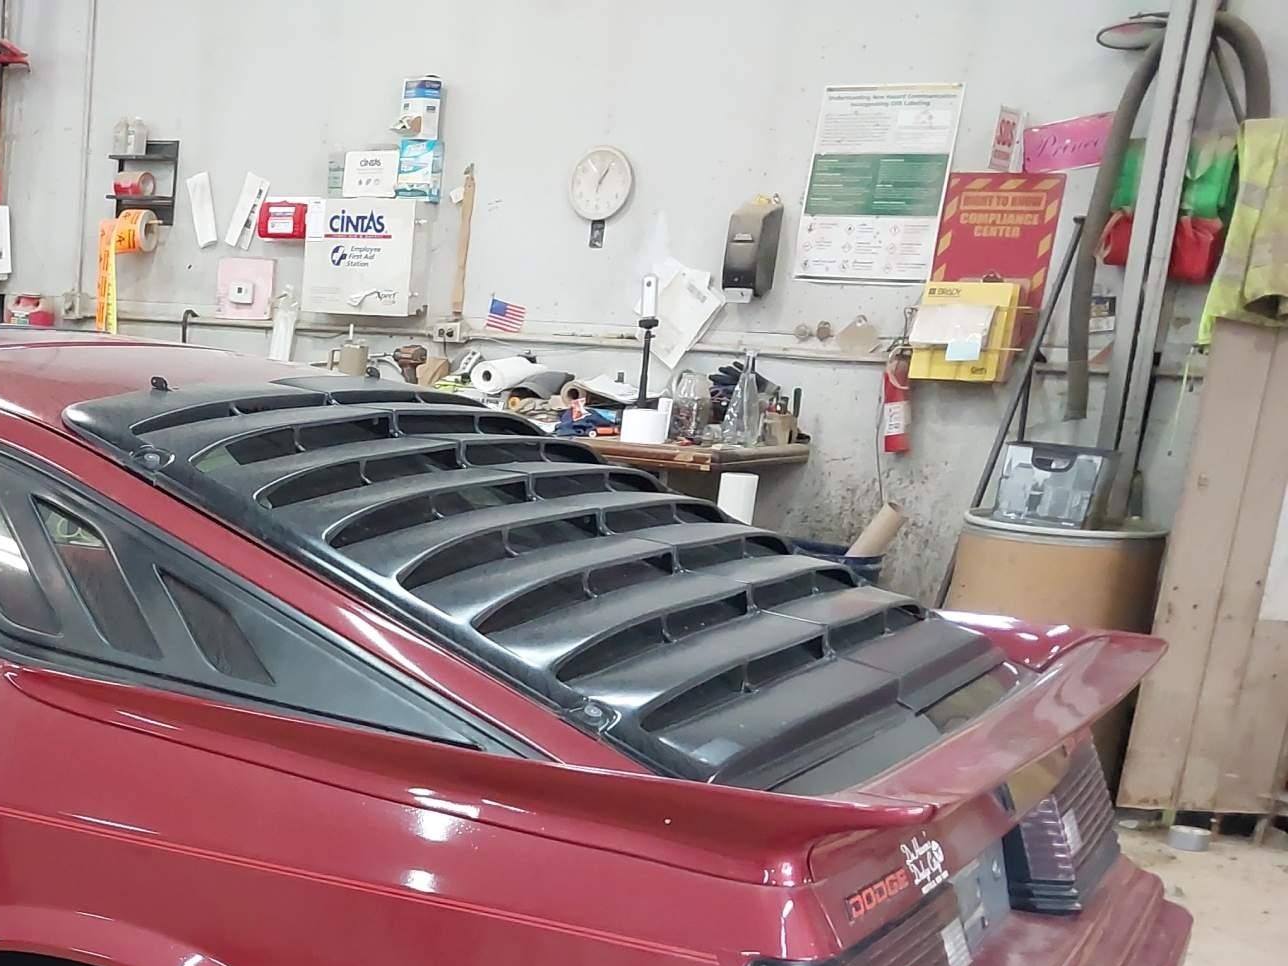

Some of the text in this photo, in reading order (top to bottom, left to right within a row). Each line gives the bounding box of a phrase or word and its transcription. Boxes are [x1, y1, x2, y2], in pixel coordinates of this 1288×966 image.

[329, 209, 385, 233] CINTAS
[959, 212, 1039, 225] COMPLIANCE
[973, 225, 1021, 238] CENTER
[350, 245, 382, 255] Employee
[846, 868, 910, 922] DODGE
